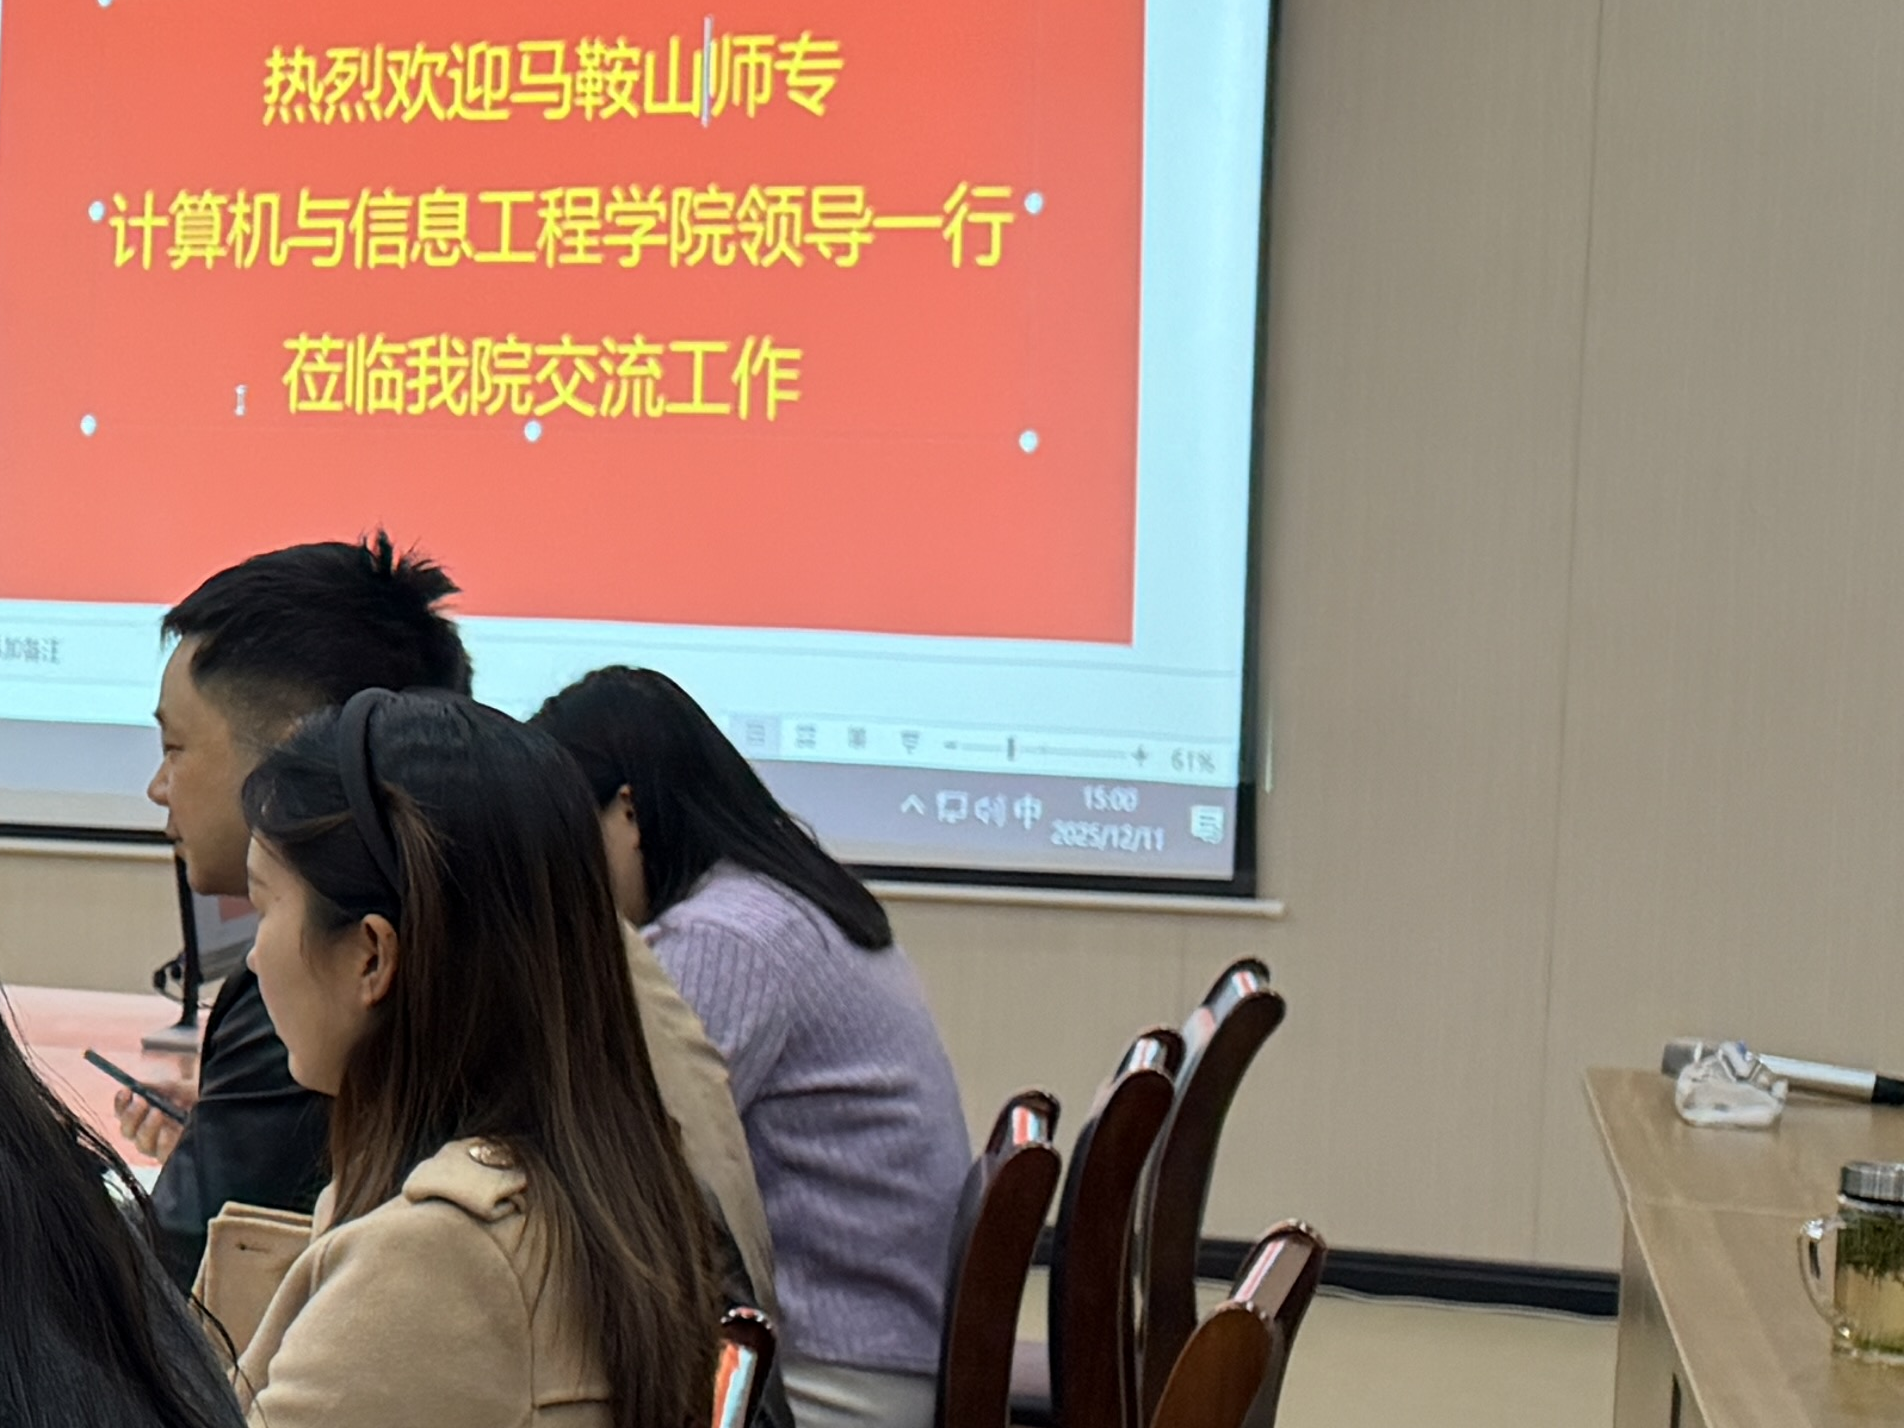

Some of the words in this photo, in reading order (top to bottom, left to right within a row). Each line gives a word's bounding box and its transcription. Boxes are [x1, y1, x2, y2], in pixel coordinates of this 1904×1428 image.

[262, 32, 844, 126] 热烈欢迎马鞍山师专
[109, 181, 1016, 270] 计算机与信息工程学院领导一行
[283, 332, 803, 421] 莅临我院交流工作
[1051, 818, 1166, 852] 2025/12/11
[1082, 785, 1140, 813] 15:00
